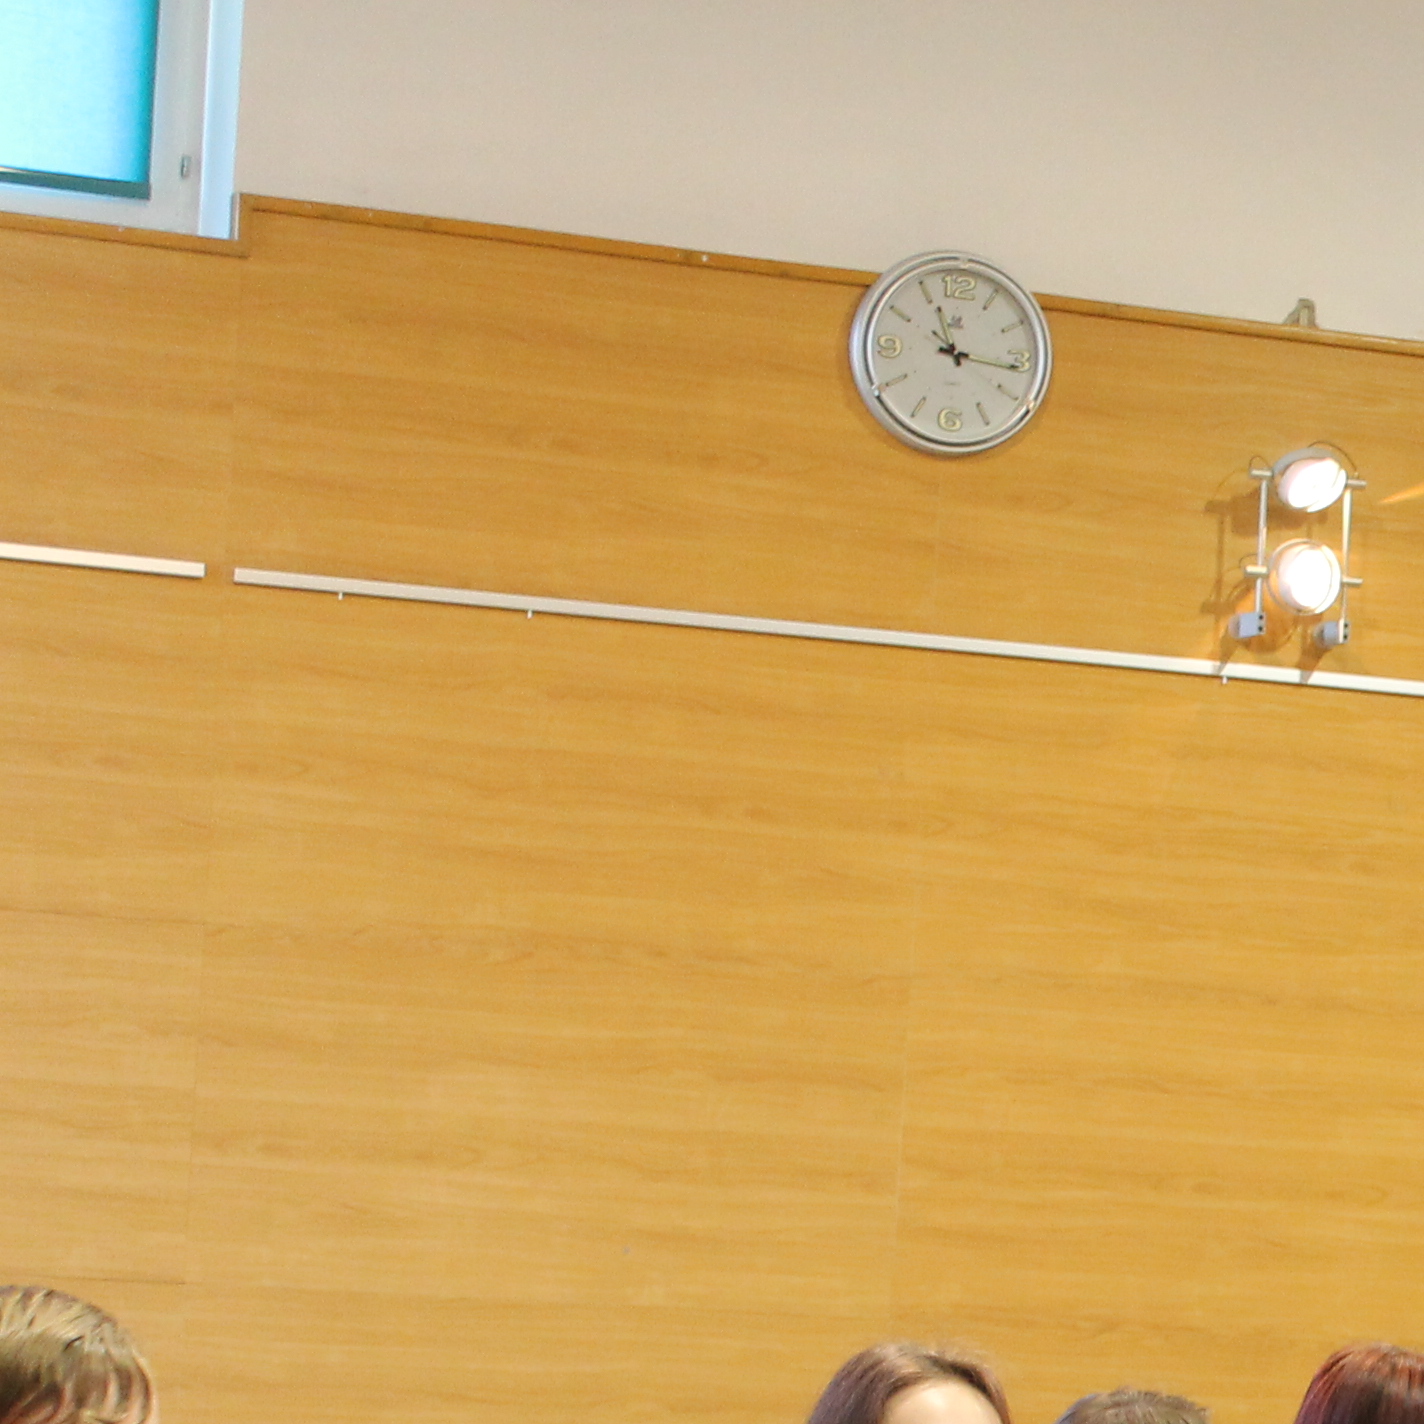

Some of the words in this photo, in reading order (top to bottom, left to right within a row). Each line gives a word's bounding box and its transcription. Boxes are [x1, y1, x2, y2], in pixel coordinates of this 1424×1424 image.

[941, 274, 977, 302] 12
[877, 334, 903, 359] 9
[1006, 349, 1031, 374] 3
[937, 407, 963, 432] 6
